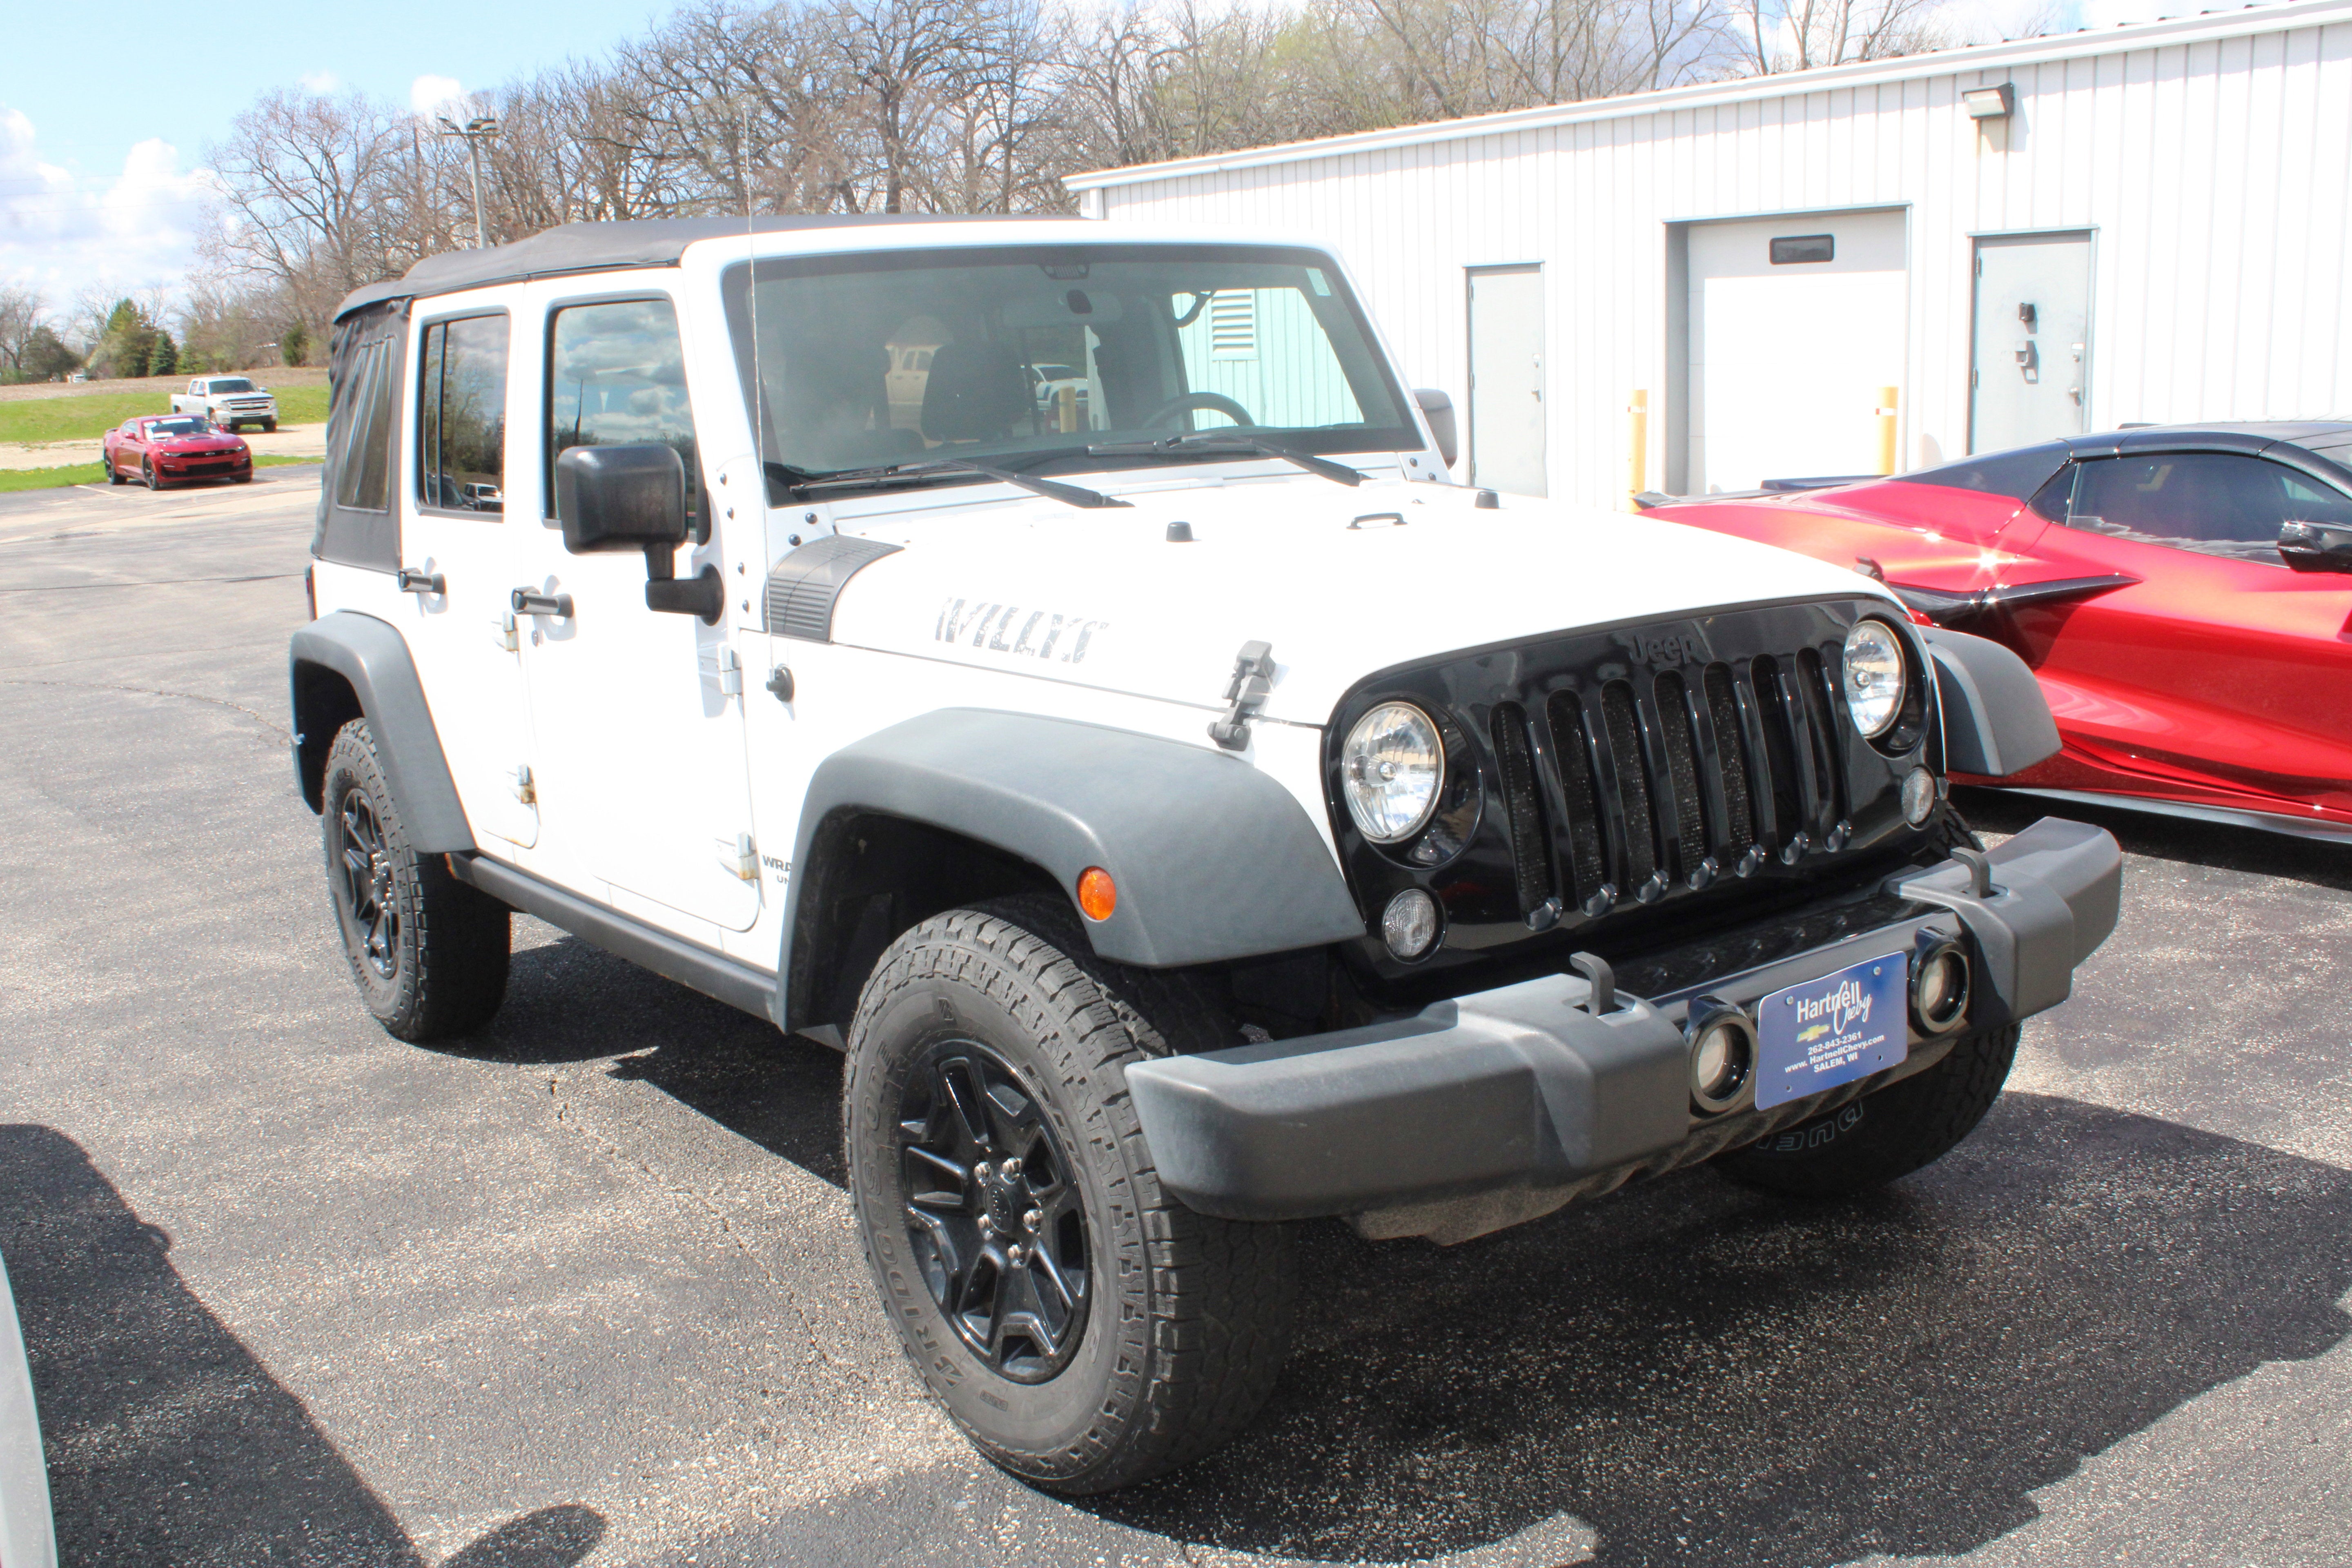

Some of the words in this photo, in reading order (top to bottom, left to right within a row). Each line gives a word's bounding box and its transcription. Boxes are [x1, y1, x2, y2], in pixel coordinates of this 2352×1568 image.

[935, 597, 1110, 664] WILLYS
[1629, 635, 1696, 665] Jeep
[1797, 981, 1860, 1022] Hartnell
[1833, 980, 1872, 1035] Chevy
[1808, 1031, 1862, 1055] 262-843-2361
[1814, 1057, 1846, 1073] SALEM,
[1846, 1052, 1858, 1062] WI
